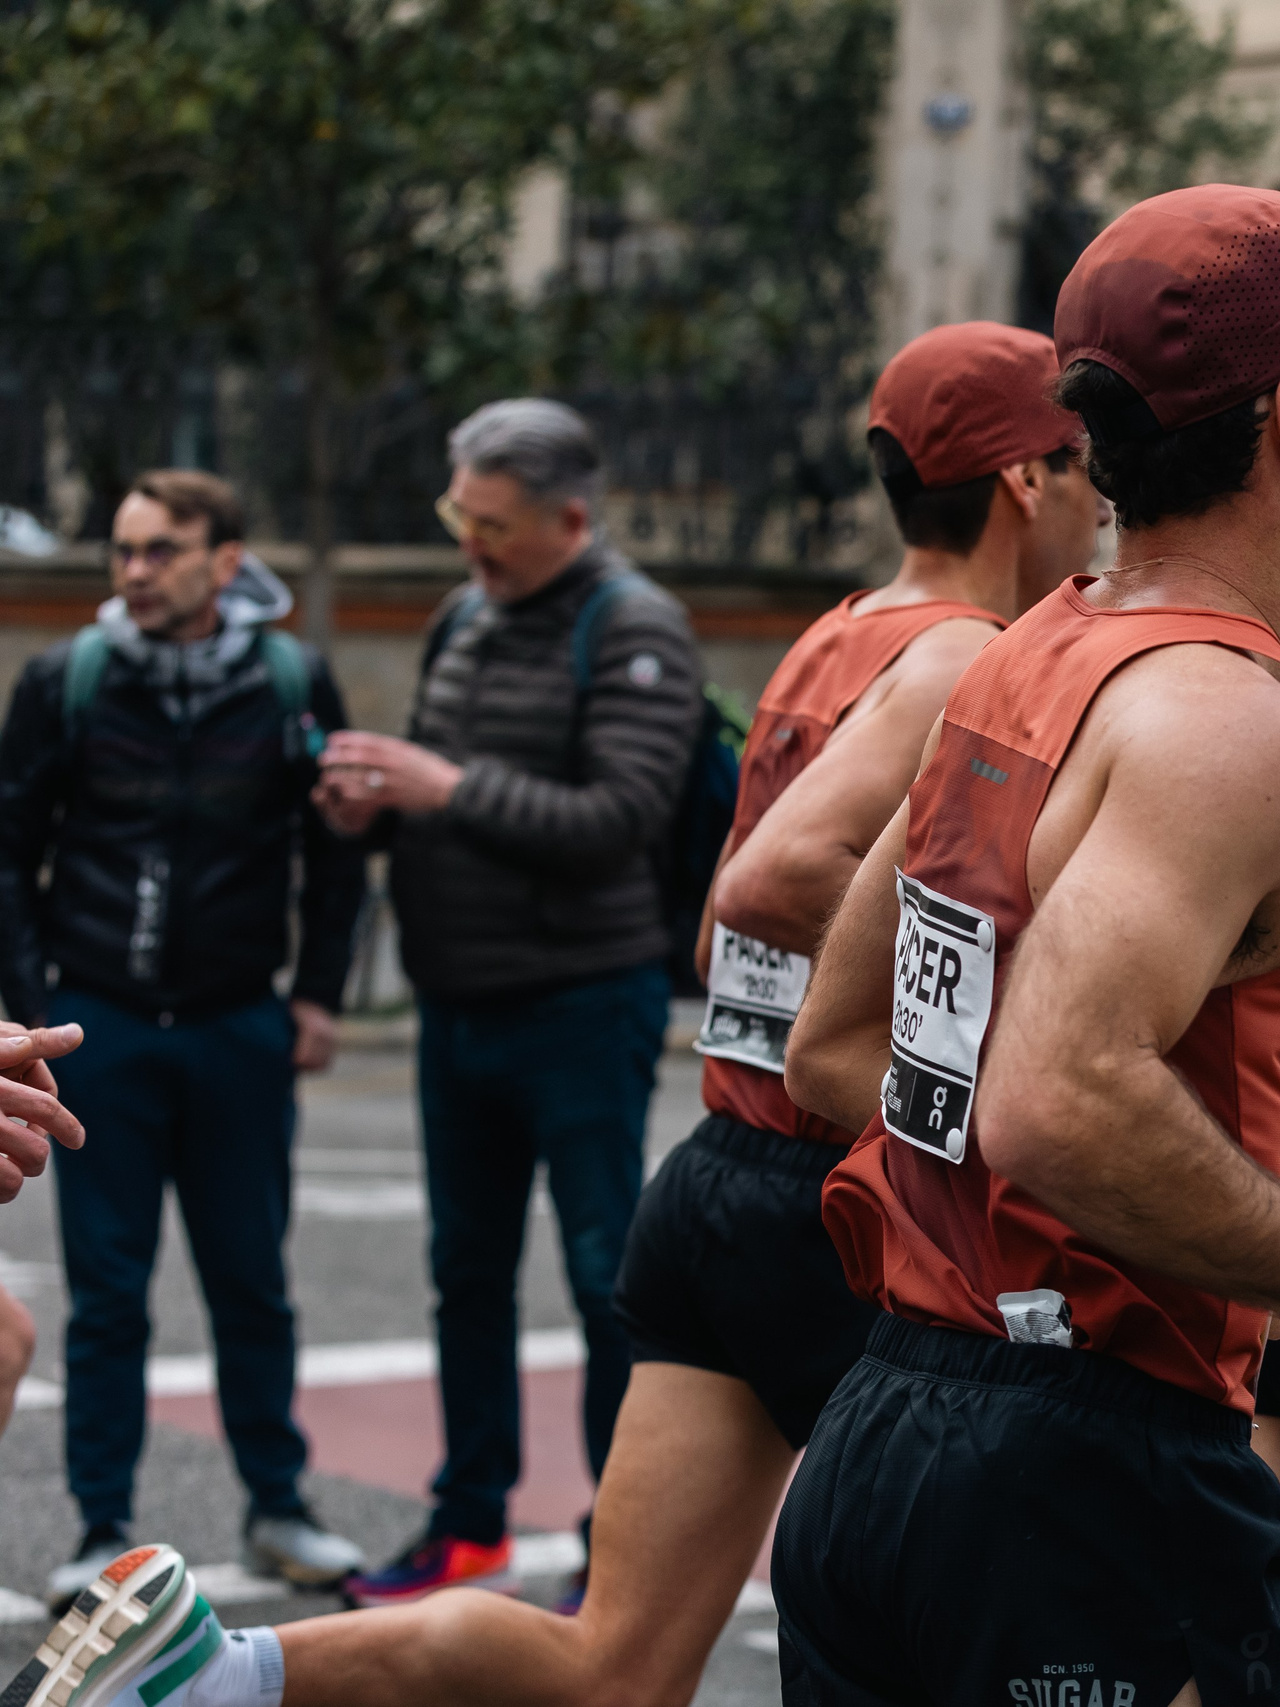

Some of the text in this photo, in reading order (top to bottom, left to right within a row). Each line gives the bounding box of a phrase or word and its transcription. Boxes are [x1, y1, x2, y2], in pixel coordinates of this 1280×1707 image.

[1043, 1663, 1095, 1675] BCN. 1950
[1008, 1678, 1136, 1707] SUGAR
